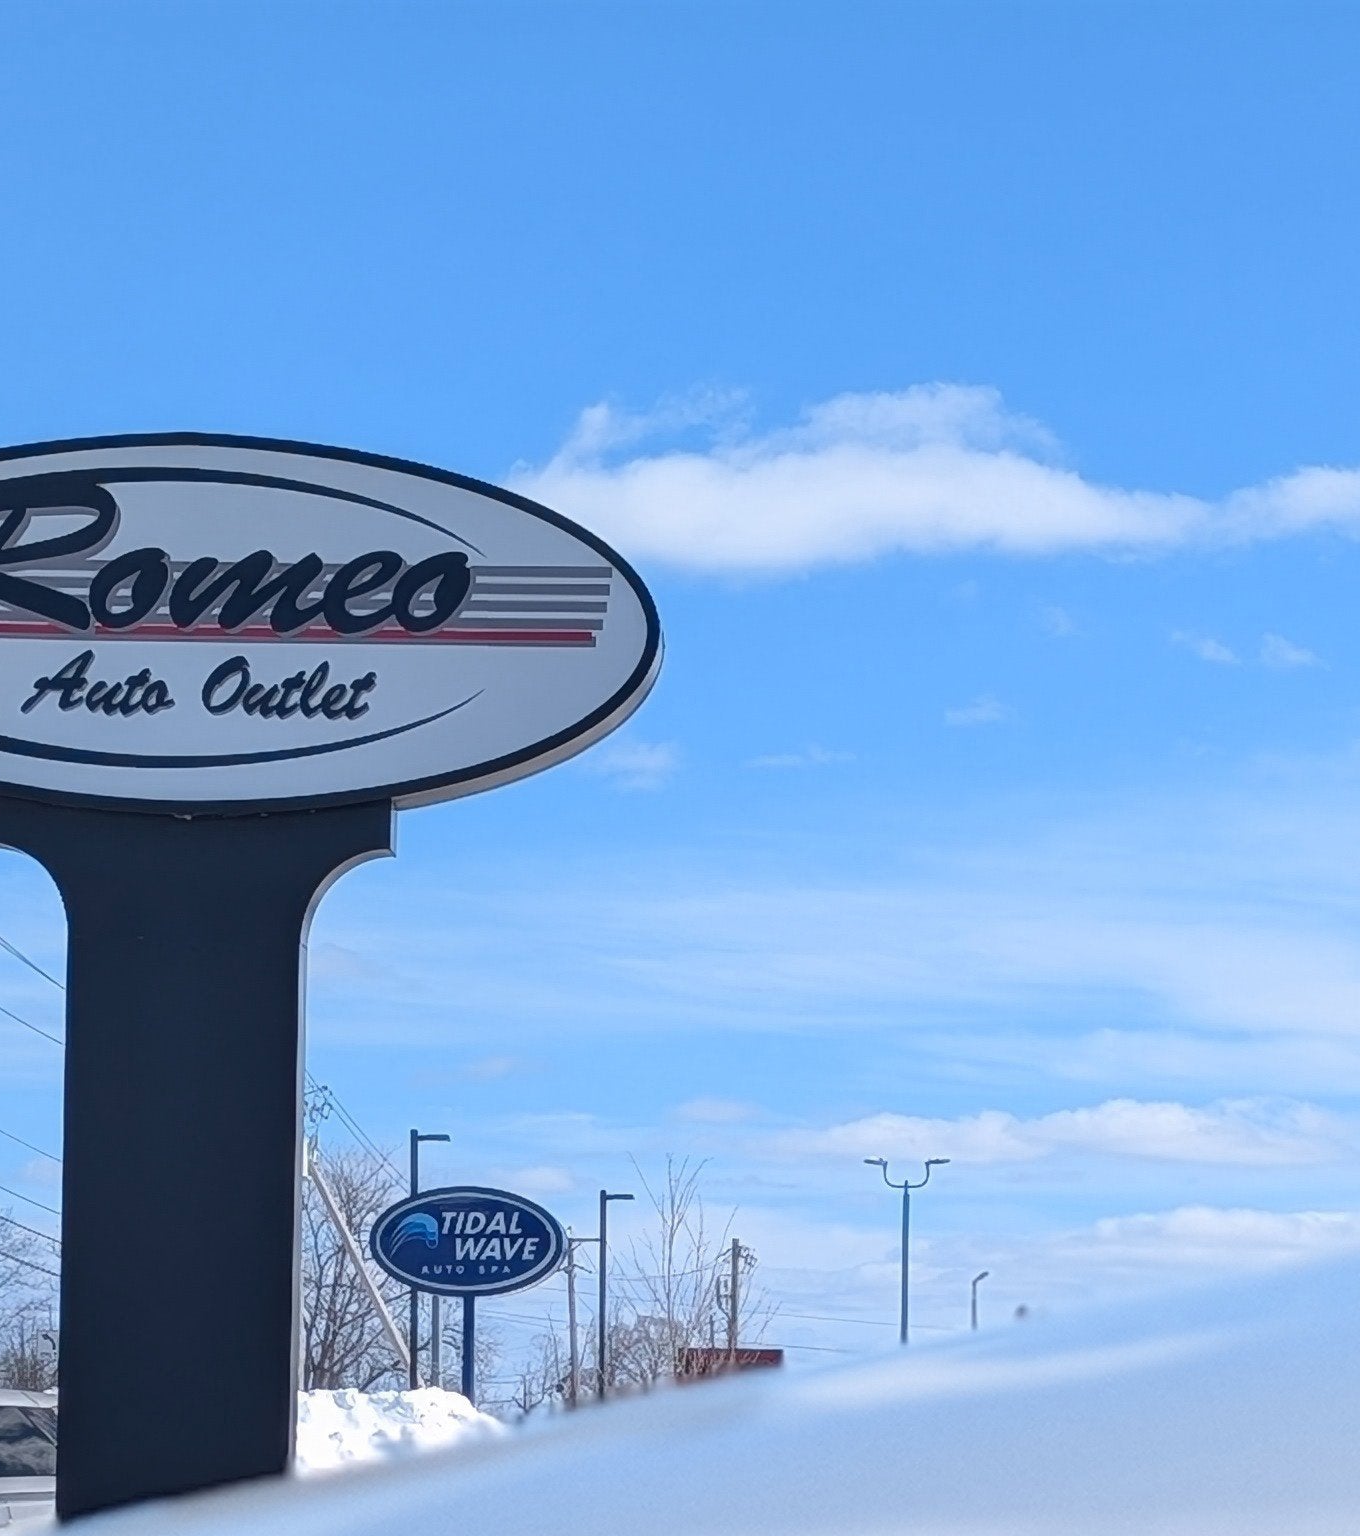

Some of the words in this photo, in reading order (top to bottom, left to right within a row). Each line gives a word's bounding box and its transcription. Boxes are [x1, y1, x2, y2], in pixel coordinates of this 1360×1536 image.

[20, 648, 177, 718] Auto
[200, 654, 378, 720] Outlet
[440, 1211, 522, 1235] TIDAL
[454, 1237, 540, 1261] WAVE
[421, 1264, 464, 1275] AUTO
[478, 1264, 511, 1275] SPA
